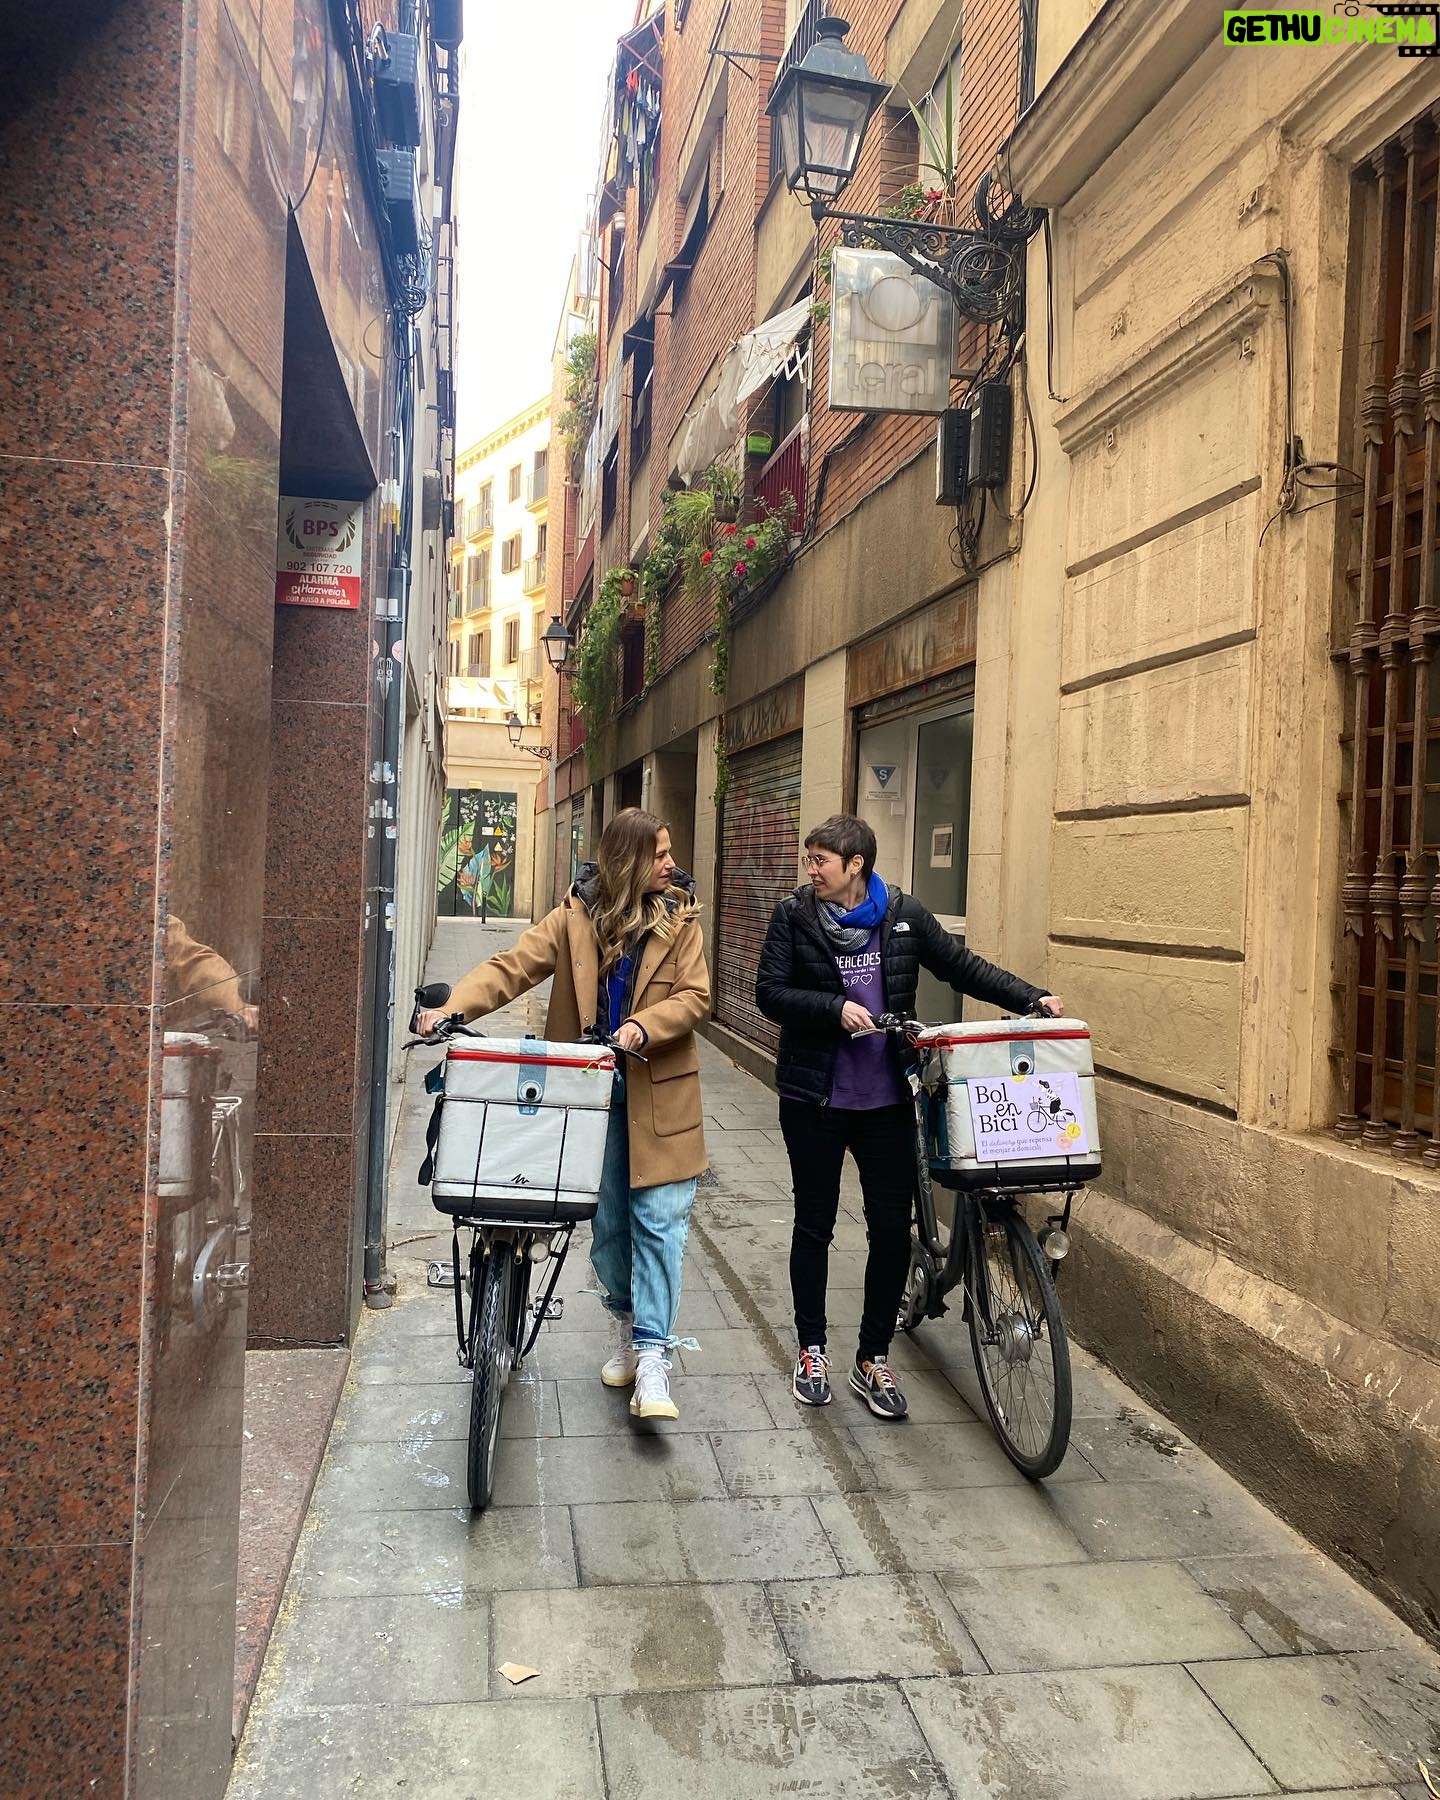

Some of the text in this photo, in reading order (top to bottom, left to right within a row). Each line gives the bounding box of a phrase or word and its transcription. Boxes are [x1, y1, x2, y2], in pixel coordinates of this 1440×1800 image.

[303, 520, 339, 537] BPS
[287, 561, 352, 574] 902 107 720
[299, 575, 339, 586] ALARMA
[879, 769, 888, 781] S
[975, 1083, 1009, 1104] Bol
[996, 1102, 1023, 1118] en
[979, 1111, 1019, 1134] Bici
[1028, 1137, 1053, 1146] repensa
[989, 1147, 1011, 1155] menjar
